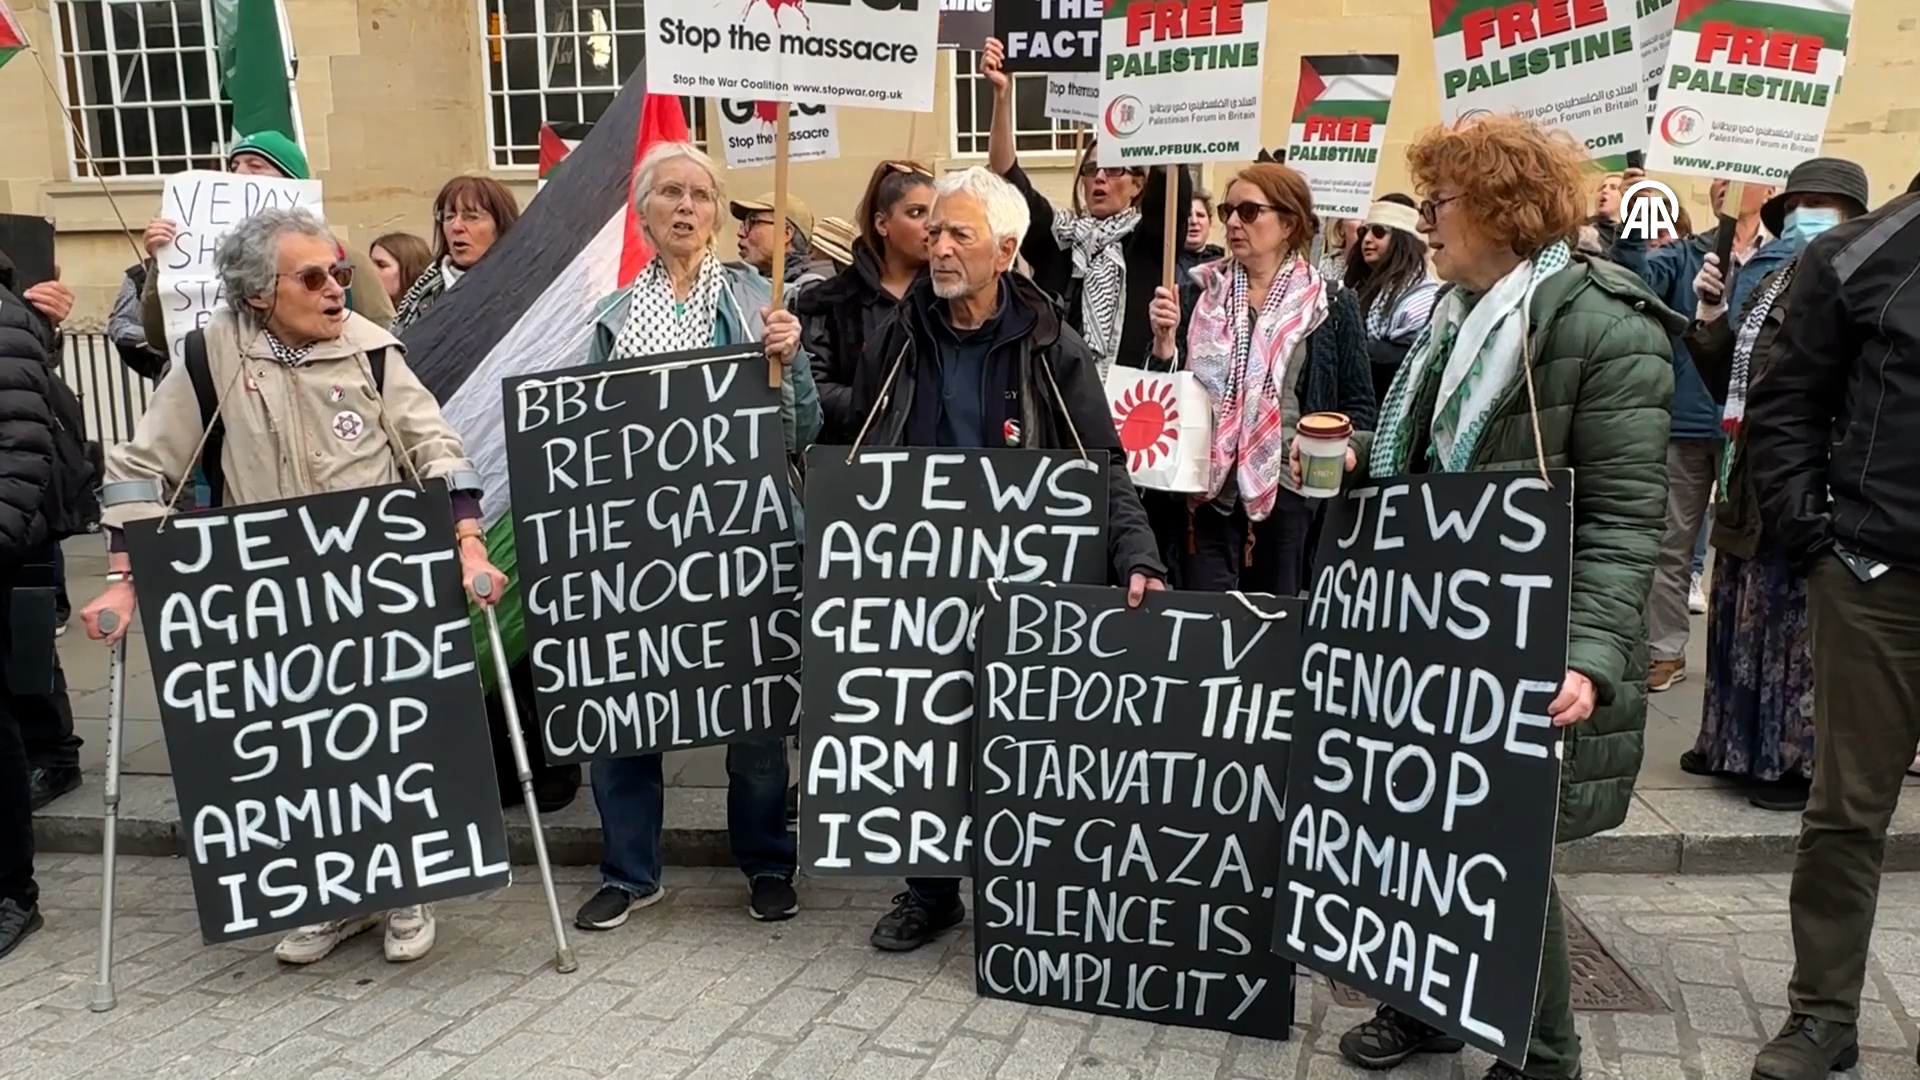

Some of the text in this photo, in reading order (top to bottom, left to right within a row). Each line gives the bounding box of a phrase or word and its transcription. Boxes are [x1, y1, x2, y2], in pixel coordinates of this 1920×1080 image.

[659, 17, 918, 64] Stop the massacre
[1126, 0, 1243, 47] FREE
[1462, 0, 1608, 61] FREE
[1695, 21, 1824, 74] FREE
[673, 74, 903, 100] Stop the War Coalition www.stopwar.org.uk
[1106, 42, 1259, 80] PALESTINE
[1444, 26, 1633, 99] PALESTINE
[1668, 65, 1830, 107] PALESTINE
[729, 136, 754, 148] Stop
[756, 133, 773, 144] the
[1149, 110, 1255, 125] Palestinian Forum in Britain
[1303, 115, 1374, 142] FREE
[1560, 109, 1591, 122] Forum
[1593, 105, 1602, 115] in
[1605, 98, 1639, 113] Britain
[1709, 133, 1815, 154] Palestinian Forum in Britain
[1120, 141, 1240, 157] WWW.PFBUK.COM
[1288, 145, 1378, 163] PALESTINE
[173, 182, 231, 227] VE
[516, 363, 739, 433] BBC TV
[541, 406, 782, 494] REPORT
[856, 452, 1099, 516] JEWS
[171, 489, 427, 573] JEWS
[522, 474, 788, 564] THE GAZA
[1338, 478, 1551, 552] JEWS
[819, 520, 1099, 582] AGAINST
[160, 550, 454, 652] AGAINST
[811, 596, 977, 656] GENO
[1005, 593, 1272, 670] BBC TV
[1308, 559, 1553, 649] AGAINST
[163, 618, 475, 722] GENOCIDE
[533, 608, 801, 693] SILENCE IS
[545, 673, 802, 757] COMPLICITY
[830, 667, 974, 725] STO
[985, 661, 1296, 744] REPORT THE
[231, 697, 429, 783] STOP
[808, 735, 973, 795] ARMI
[194, 763, 439, 865] ARMING
[983, 735, 1287, 823] STARVATION
[1313, 728, 1490, 832] STOP
[984, 808, 1065, 867] OF
[1287, 803, 1508, 941] ARMING
[218, 822, 509, 933] ISRAEL
[986, 875, 1252, 956] SILENCE IS
[984, 943, 1267, 1020] COMPLICITY
[1286, 881, 1506, 1047] ISRAEL
